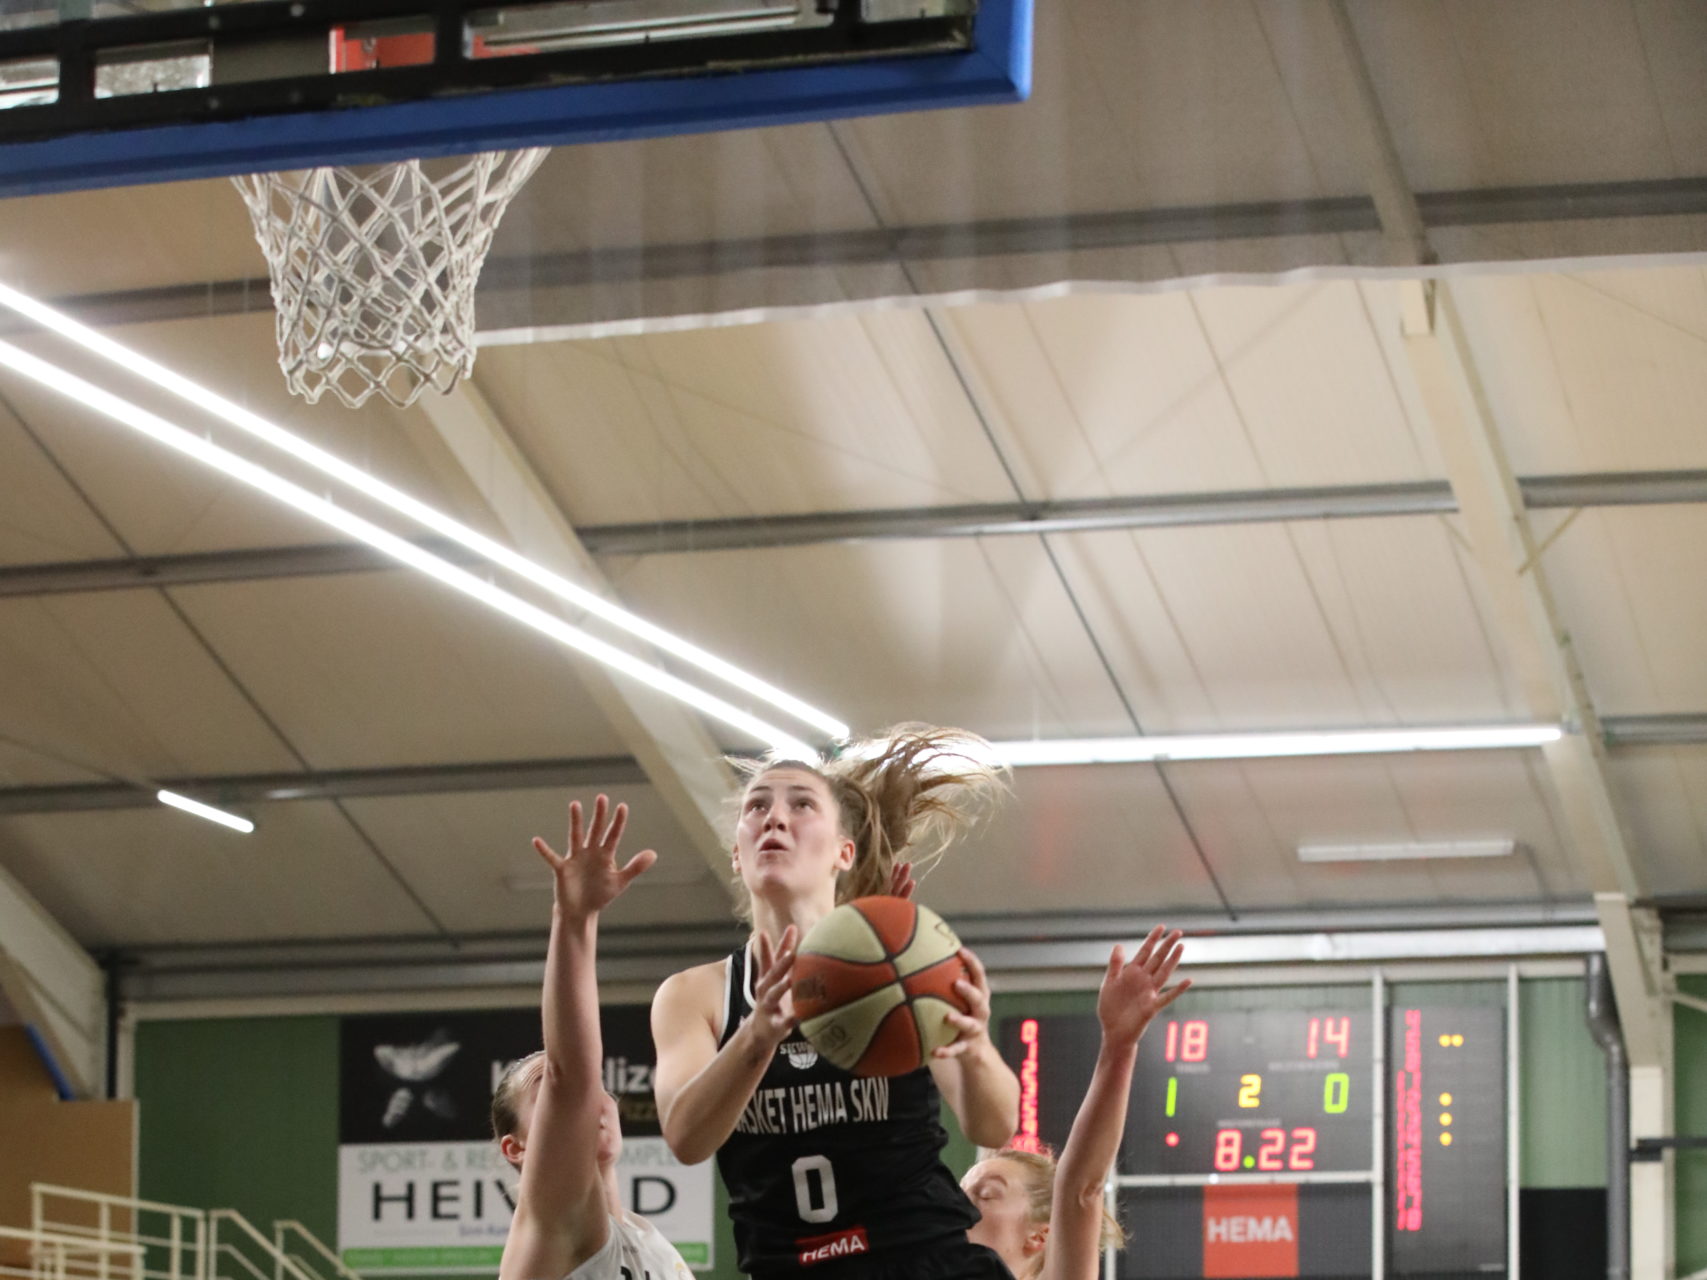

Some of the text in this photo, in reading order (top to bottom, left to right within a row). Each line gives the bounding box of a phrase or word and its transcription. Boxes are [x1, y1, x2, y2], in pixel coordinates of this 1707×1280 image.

[1165, 1020, 1209, 1062] 18
[1307, 1017, 1350, 1059] 14
[789, 1082, 848, 1133] HEMA
[850, 1076, 889, 1122] SKW
[1165, 1076, 1179, 1118] 1
[1238, 1074, 1262, 1108] 2
[1323, 1073, 1350, 1115] 0
[791, 1155, 838, 1223] 0
[802, 1235, 865, 1262] HEMA
[1207, 1216, 1293, 1243] HEMA
